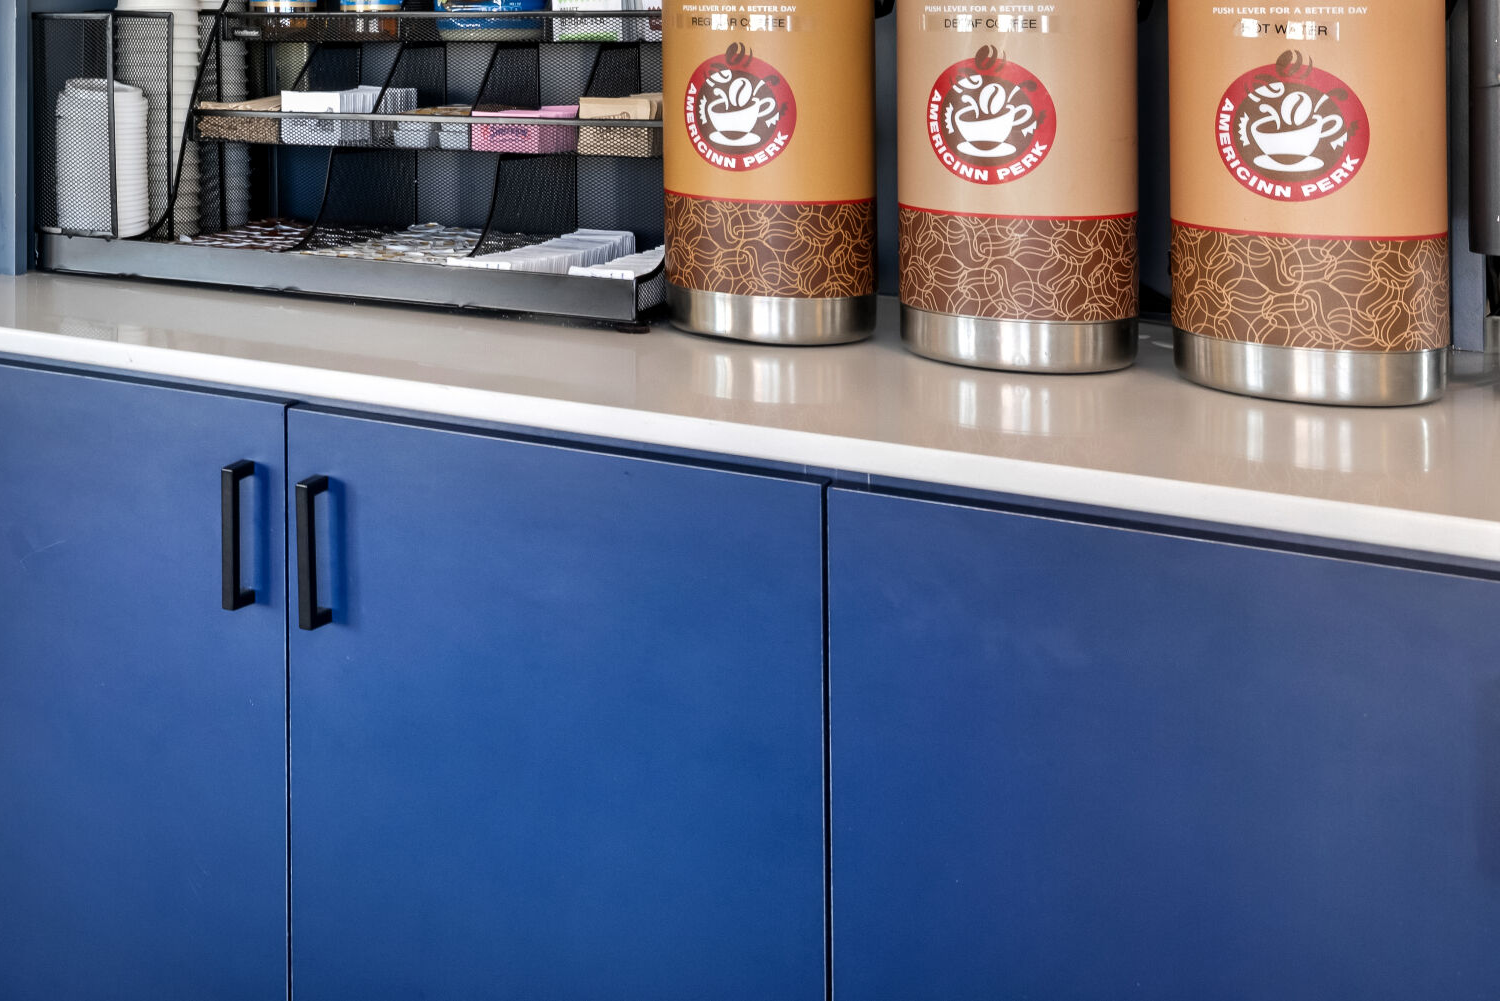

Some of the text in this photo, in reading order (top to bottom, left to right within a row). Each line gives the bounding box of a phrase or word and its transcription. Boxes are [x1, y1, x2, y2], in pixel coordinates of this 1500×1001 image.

[692, 17, 785, 28] REGR CFEE
[944, 18, 1037, 28] DEAF CFEE
[1242, 23, 1270, 34] OT
[686, 82, 788, 168] AMERICINN PERK
[929, 89, 1048, 181] AMERICINN PERK
[1218, 97, 1360, 198] AMERICINN PERK
